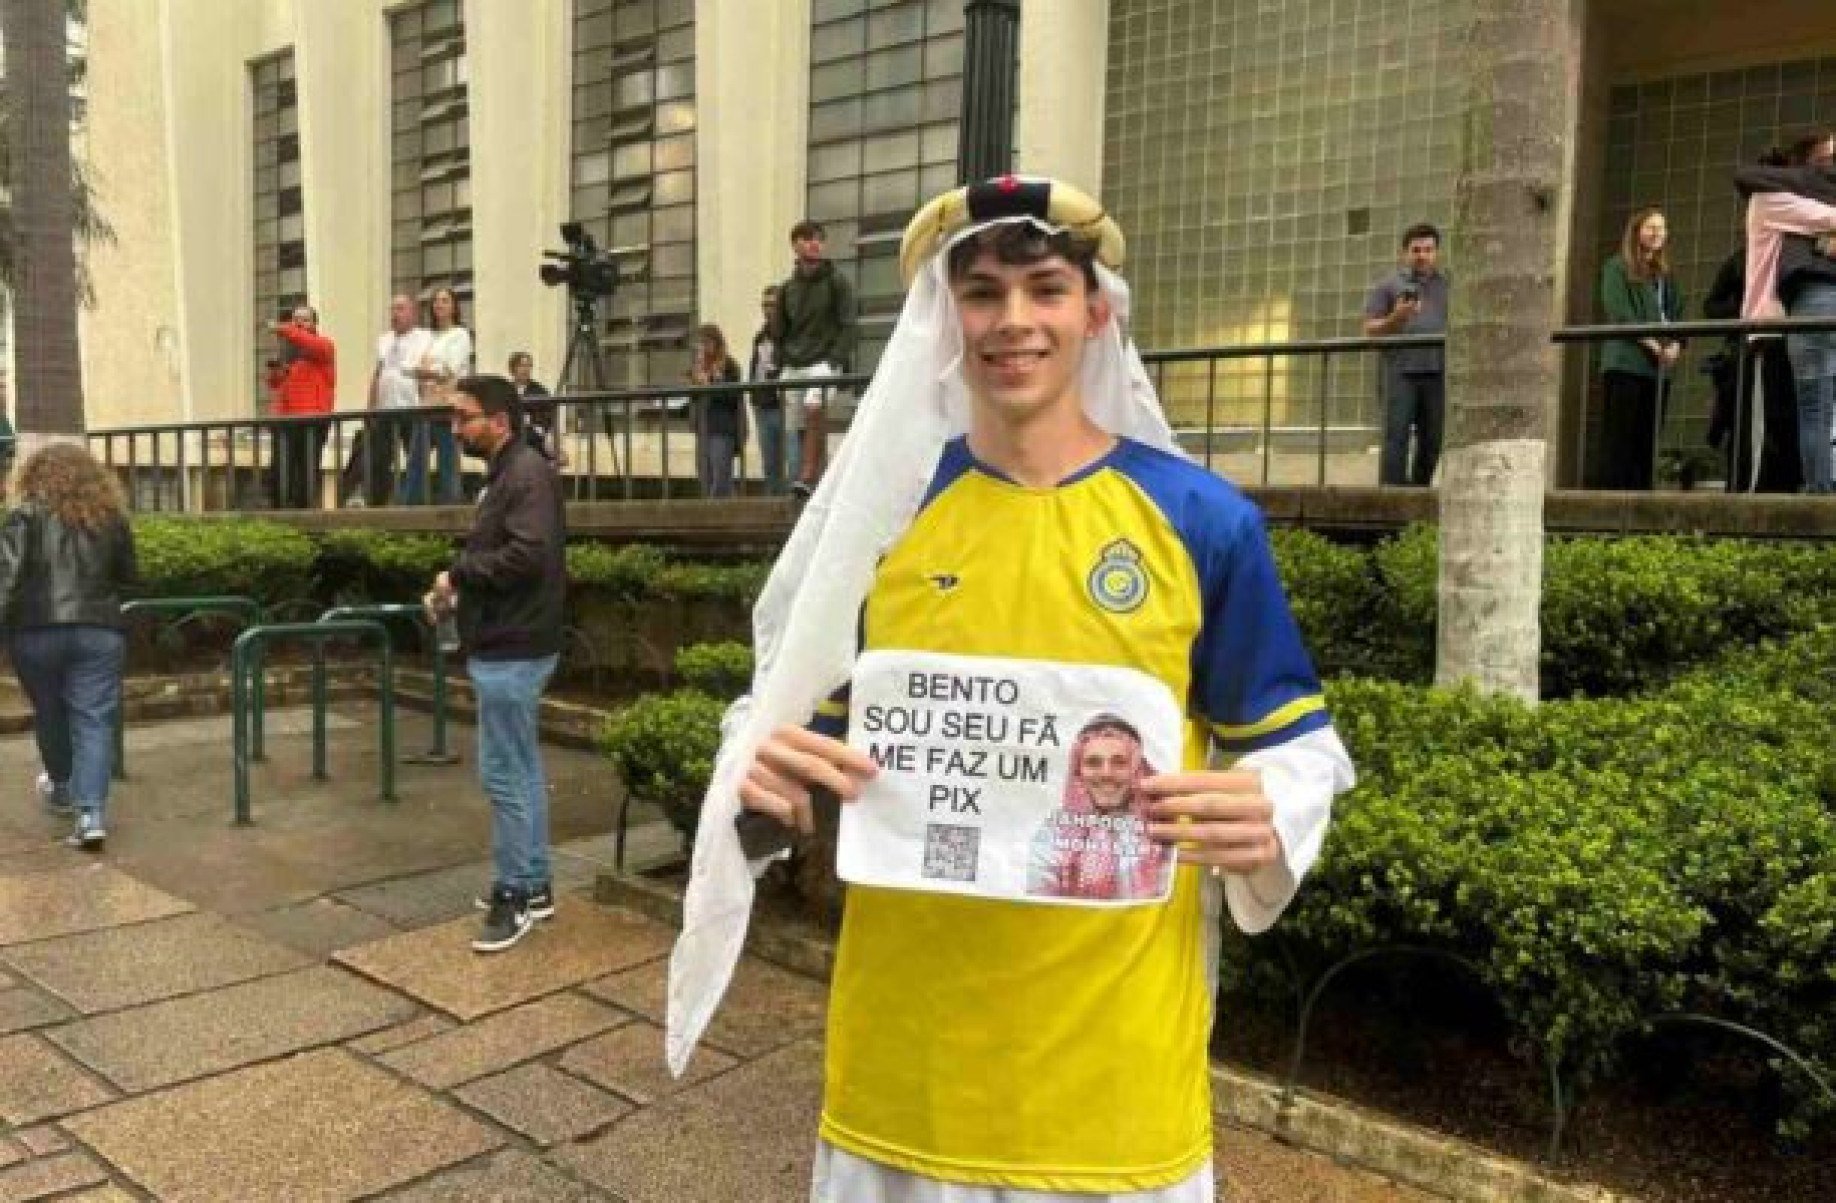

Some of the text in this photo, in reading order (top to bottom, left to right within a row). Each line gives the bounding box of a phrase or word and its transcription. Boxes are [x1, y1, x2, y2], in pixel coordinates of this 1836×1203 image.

[908, 673, 1018, 705] BENTO
[864, 706, 1061, 747] SOU SEU FÃ
[869, 743, 1048, 783] ME FAZ UM
[929, 784, 981, 814] PIX
